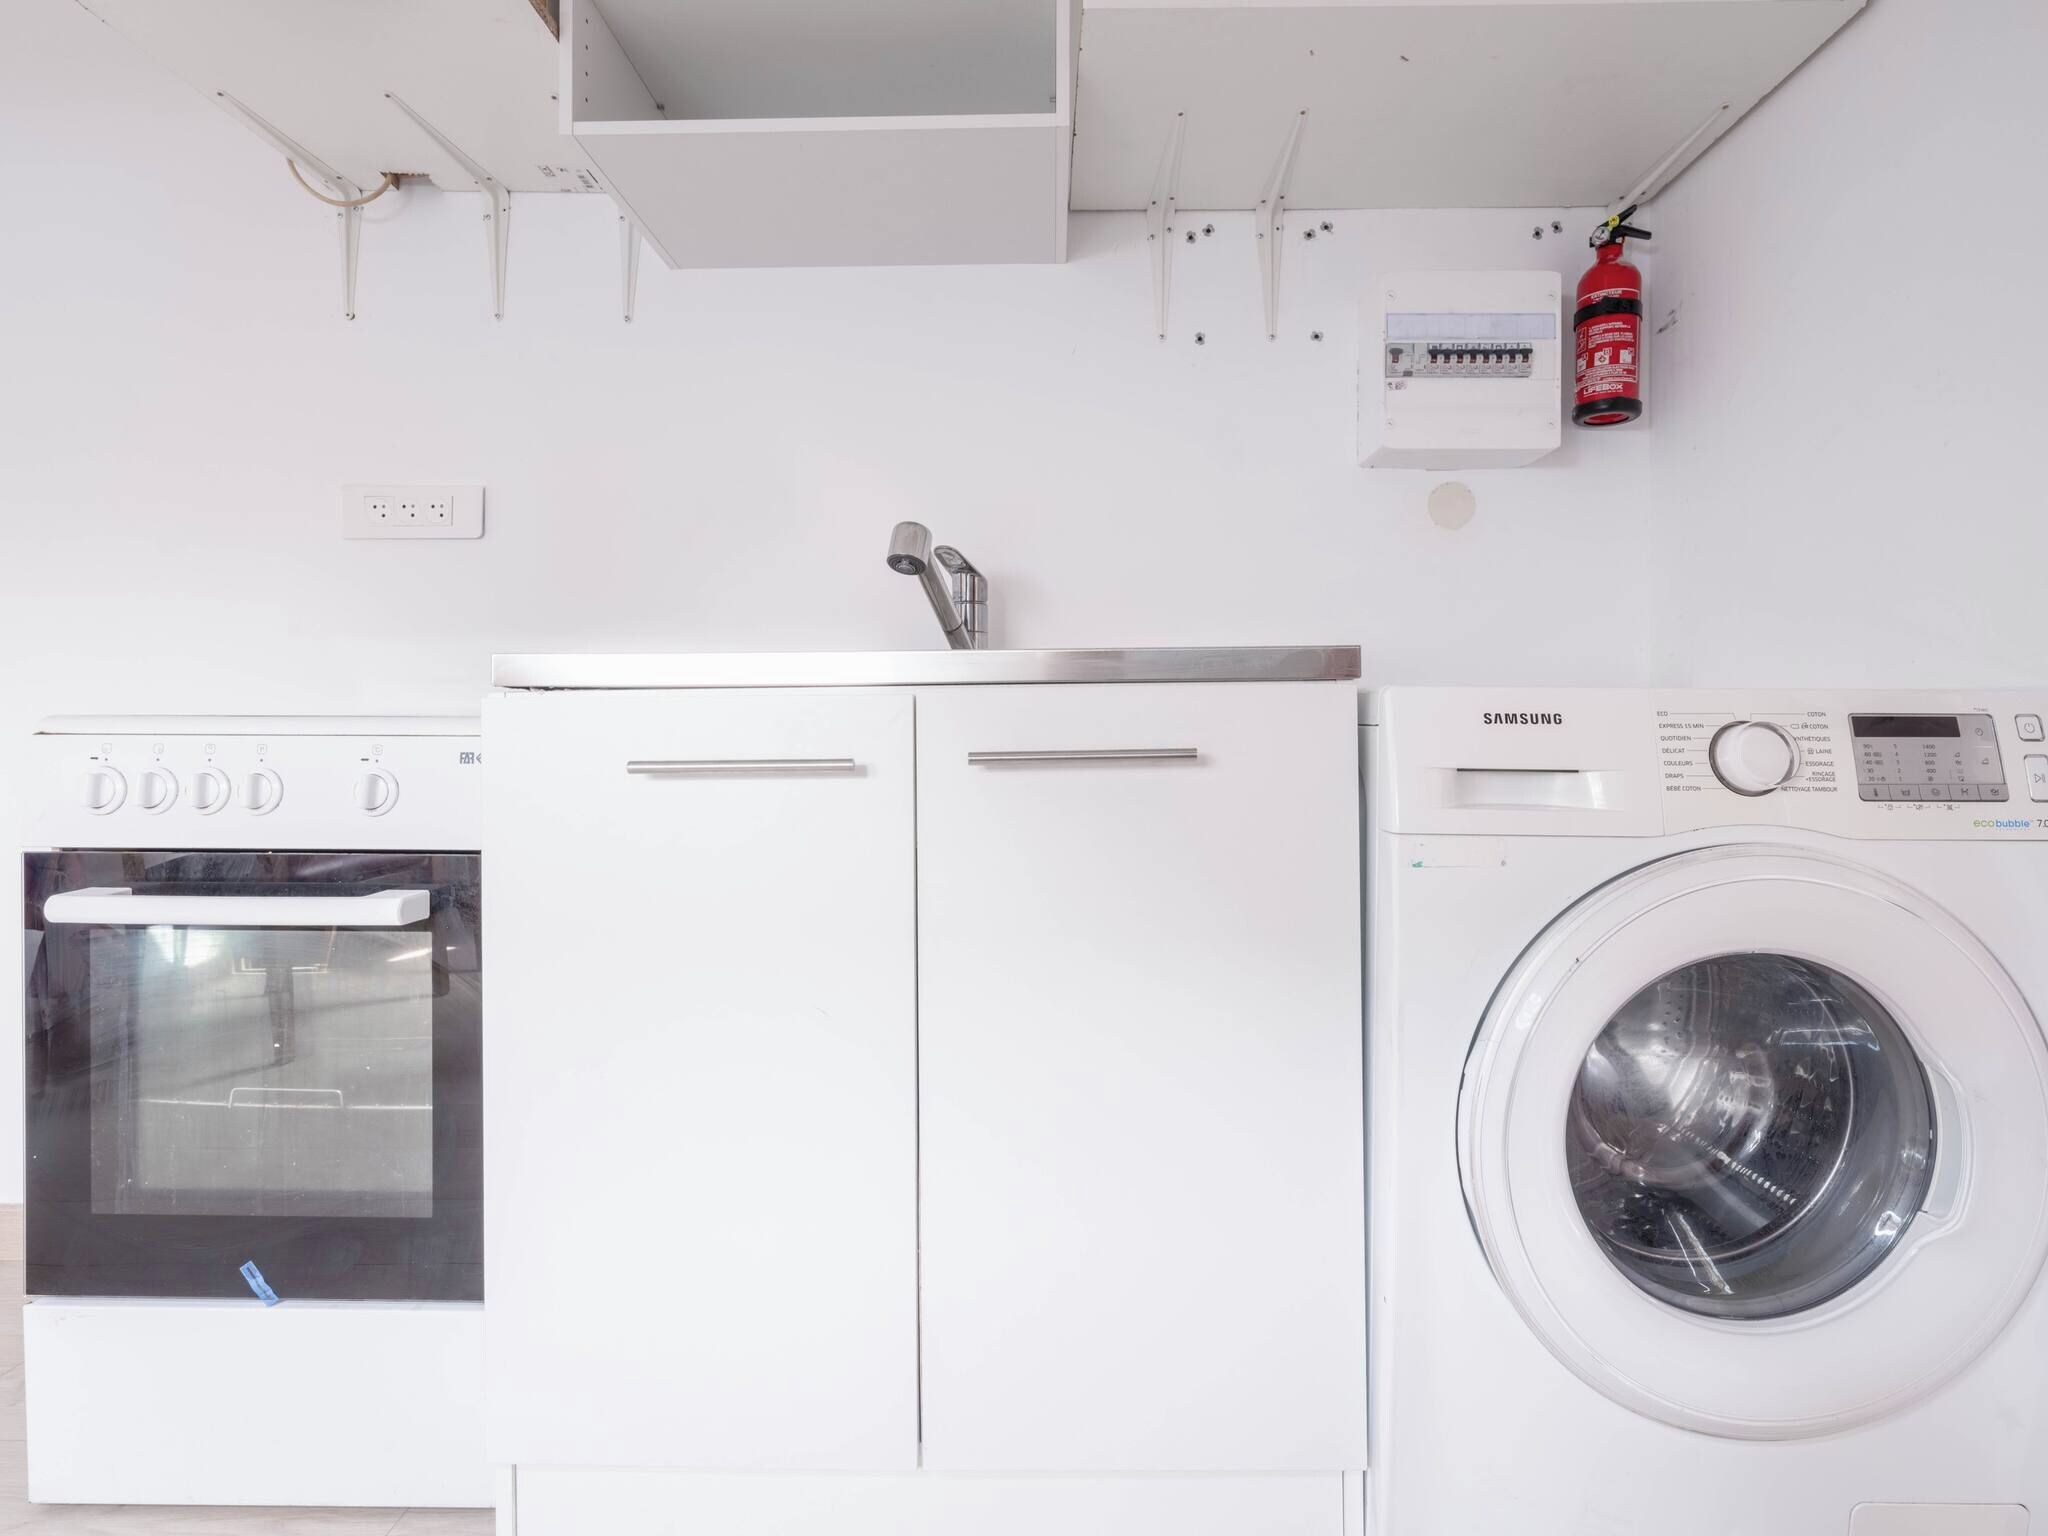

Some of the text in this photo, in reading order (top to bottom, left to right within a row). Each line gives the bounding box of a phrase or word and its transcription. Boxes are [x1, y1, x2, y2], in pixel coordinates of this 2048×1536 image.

[1583, 383, 1624, 395] LIFEBOX
[1483, 712, 1563, 725] SAMSUNG
[1973, 818, 2030, 828] ecobubble
